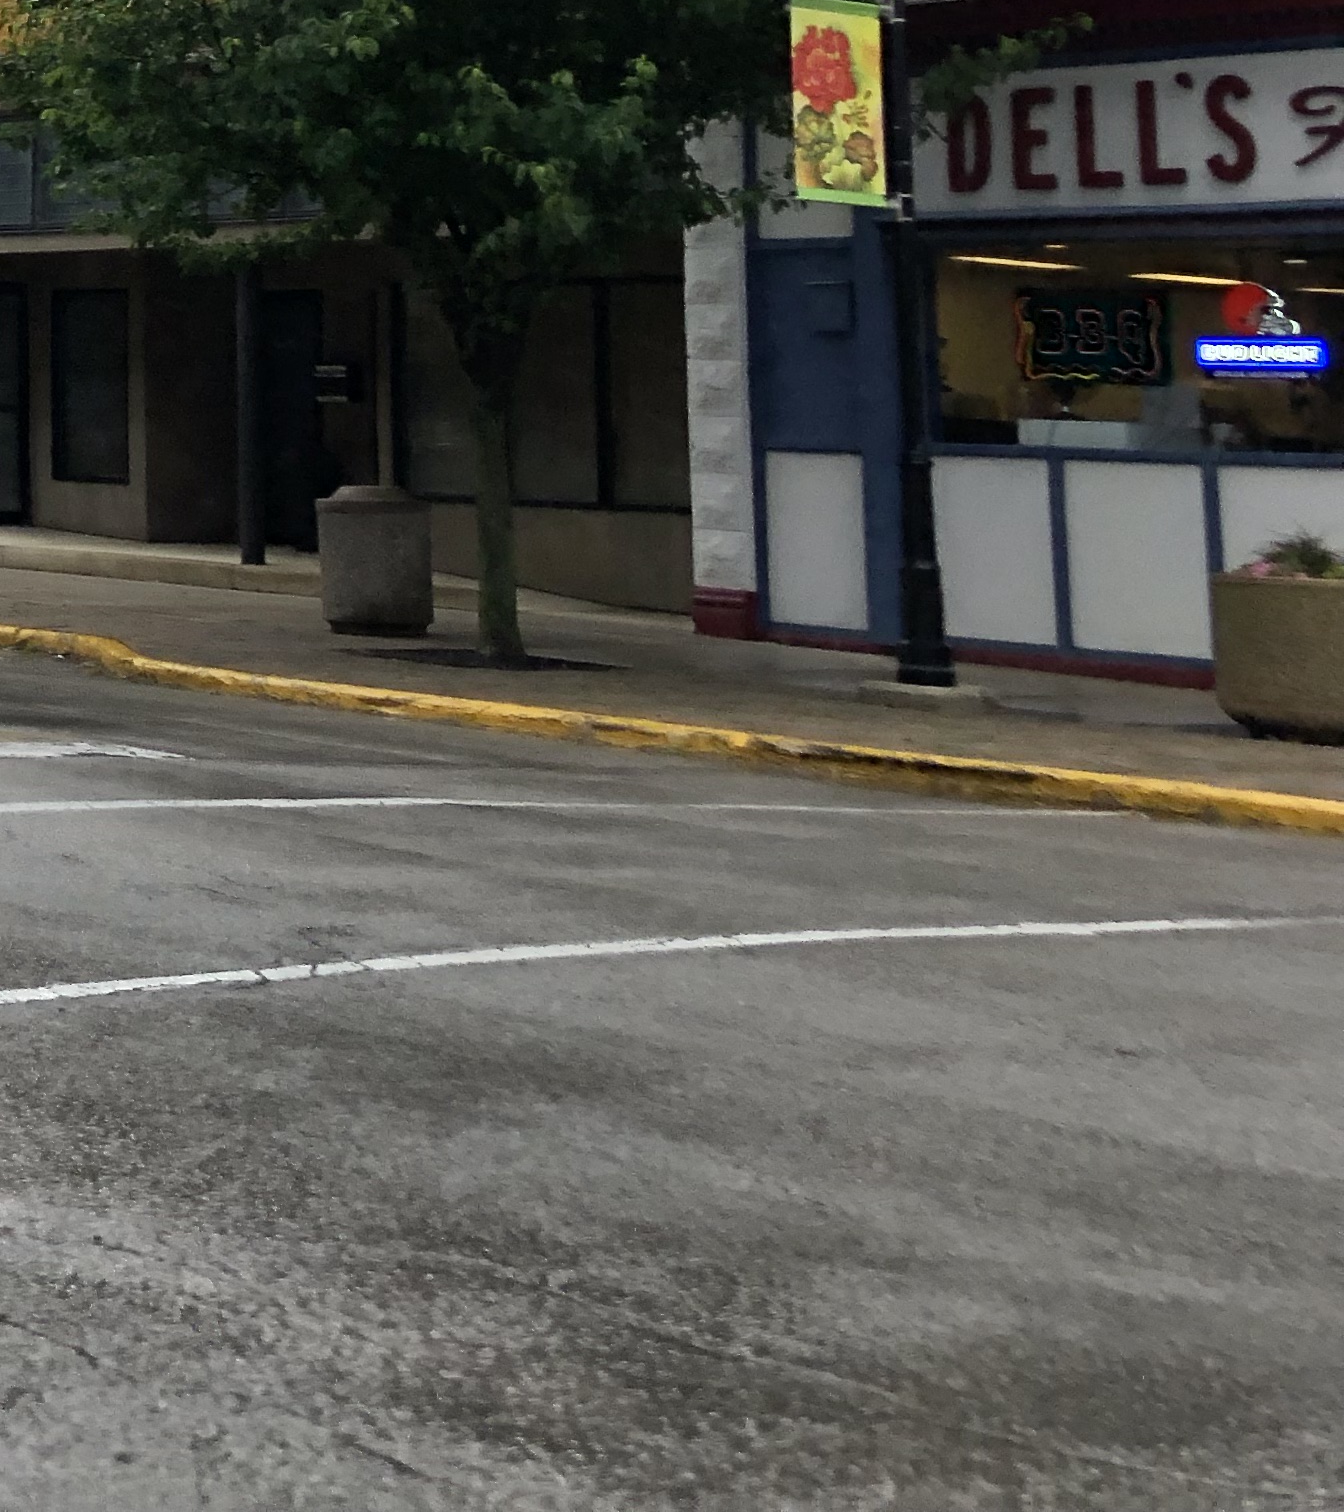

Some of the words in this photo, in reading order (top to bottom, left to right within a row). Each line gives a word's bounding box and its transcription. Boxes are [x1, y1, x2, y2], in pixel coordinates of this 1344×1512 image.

[946, 71, 1258, 194] DELL'S
[1199, 343, 1249, 362] BUD
[1249, 344, 1322, 363] LIGHT
